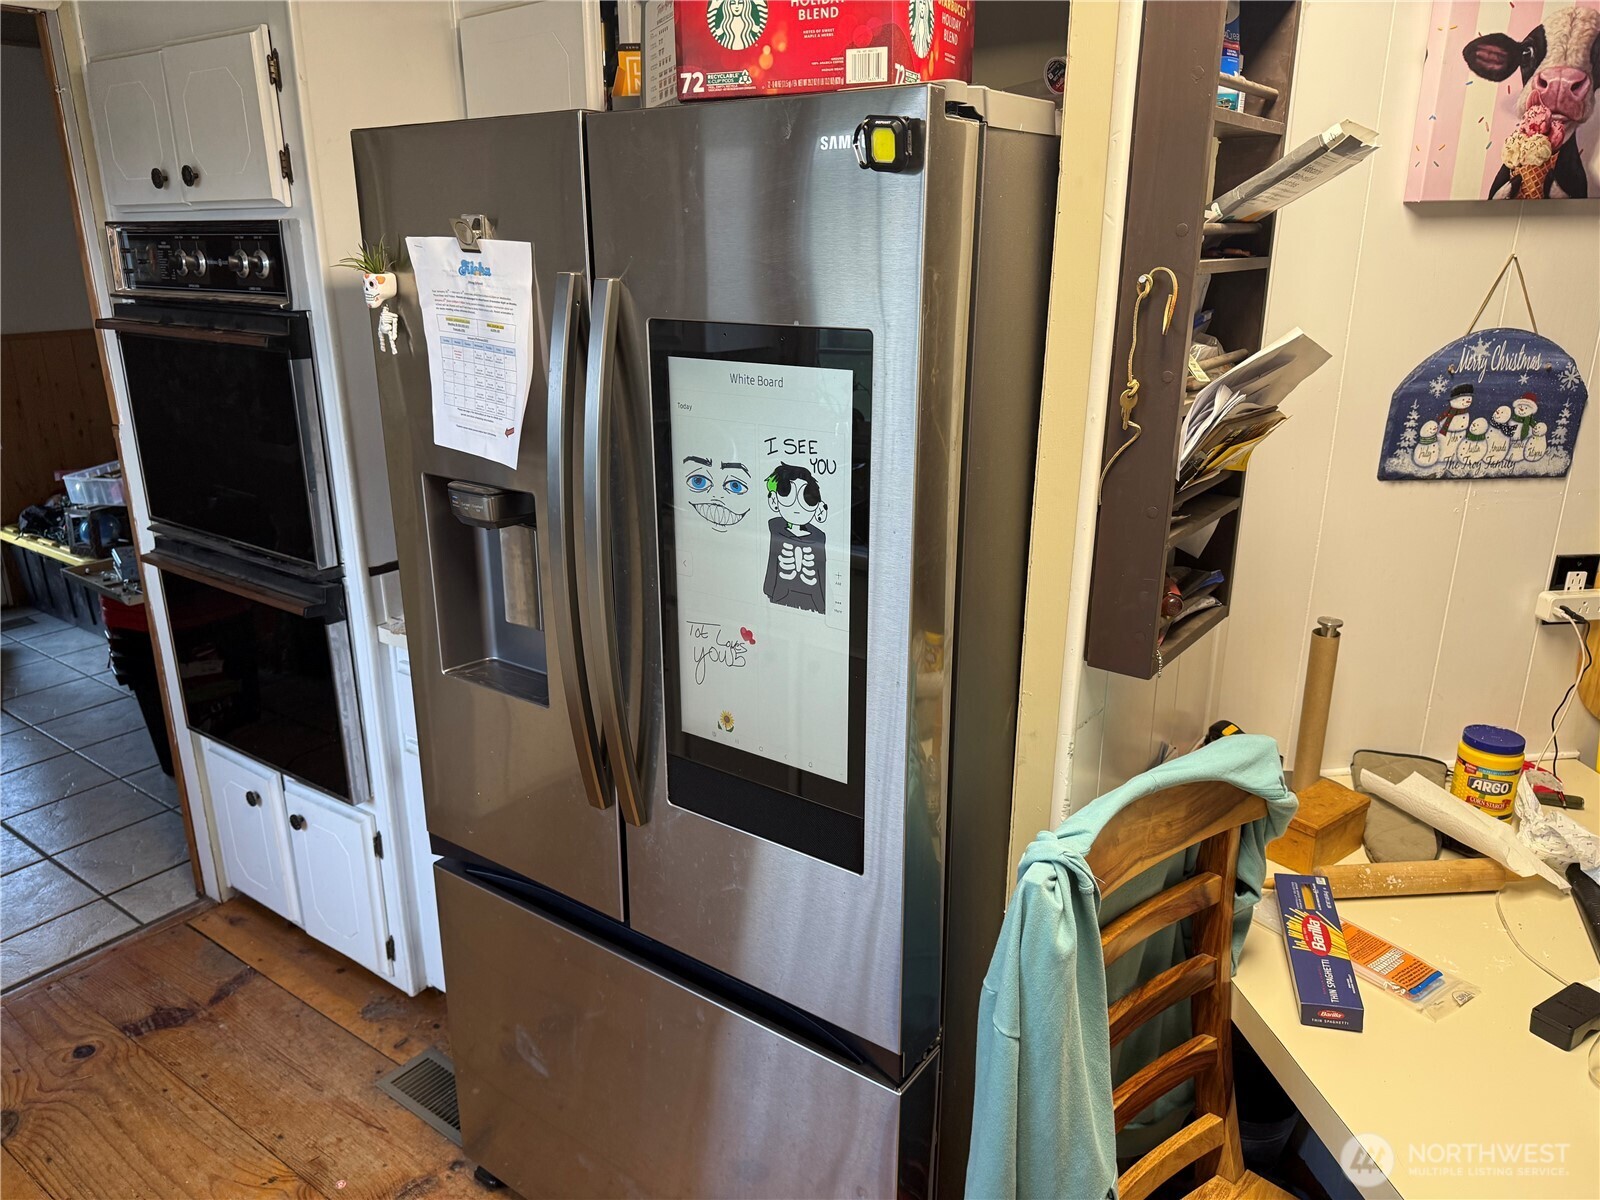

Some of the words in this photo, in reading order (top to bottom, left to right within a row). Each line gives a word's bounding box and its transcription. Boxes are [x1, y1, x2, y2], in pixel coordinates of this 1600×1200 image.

[798, 6, 839, 21] BLEND
[941, 12, 962, 32] HOLIDAY
[943, 28, 959, 46] BLEND
[680, 71, 705, 94] 72
[1454, 344, 1487, 383] Merry
[1491, 340, 1542, 372] Christmas
[729, 373, 756, 387] White
[757, 375, 784, 388] Board
[677, 402, 693, 412] Today
[764, 437, 778, 455] I
[783, 438, 818, 455] SEE
[809, 458, 837, 475] YOU
[1443, 454, 1460, 471] The
[1460, 456, 1483, 476] Troy
[1483, 453, 1516, 475] Family
[1471, 779, 1509, 794] ARGO
[1469, 796, 1486, 806] CORN
[1486, 800, 1505, 809] STARCH
[1309, 918, 1326, 951] Barilla
[1322, 959, 1336, 990] SPAGHETTI
[1331, 990, 1339, 1003] THIN
